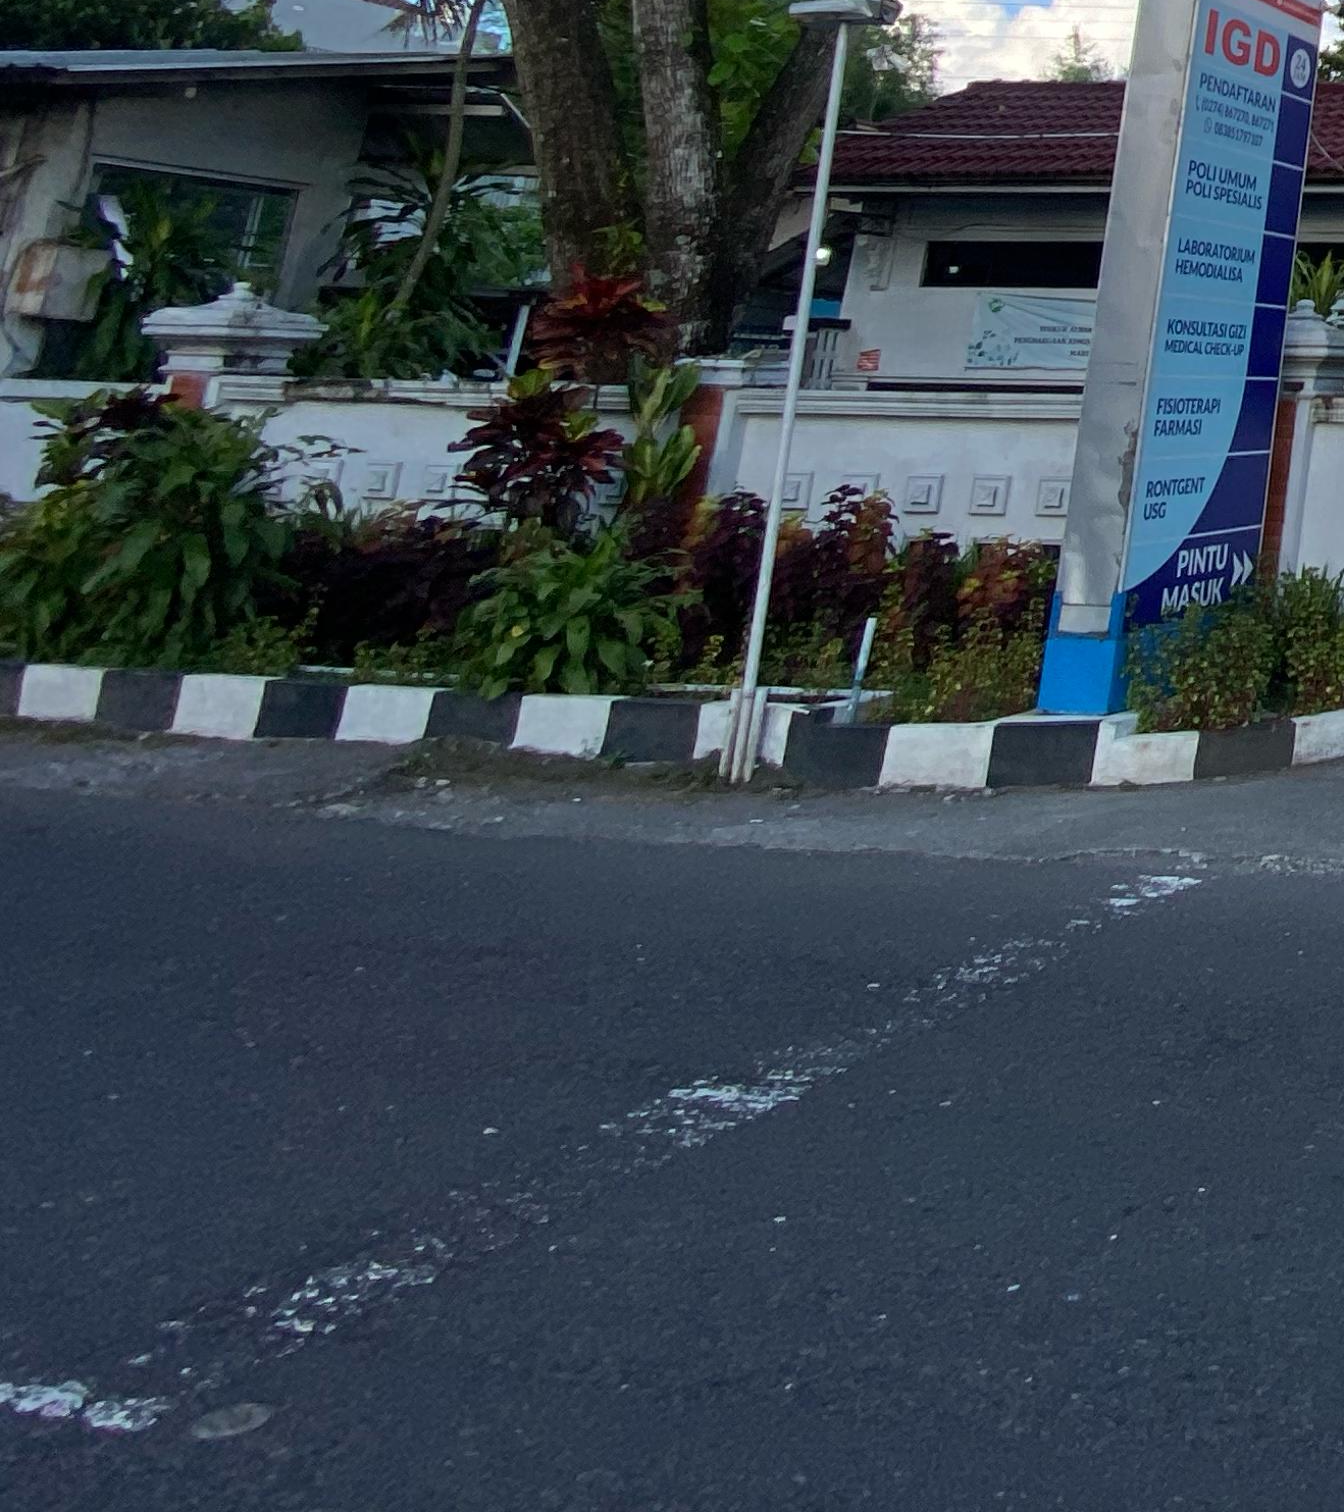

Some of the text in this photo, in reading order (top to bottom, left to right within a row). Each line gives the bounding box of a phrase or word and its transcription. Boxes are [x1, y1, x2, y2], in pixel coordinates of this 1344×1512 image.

[1204, 8, 1280, 77] IGD
[1295, 54, 1307, 72] 24
[1200, 72, 1276, 113] PENDAFTARAN
[1188, 160, 1257, 192] POLI UMUM
[1185, 179, 1263, 210] POLI SPESIALIS
[1178, 237, 1256, 264] LABORATORIUM
[1175, 259, 1243, 283] HEMODIALISA
[1167, 318, 1247, 339] KONSULTASI GIZI
[1165, 340, 1245, 357] MEDICAL CHECK-UP
[1156, 398, 1221, 415] FISIOTERAPI
[1154, 419, 1202, 437] FARMASI
[1146, 477, 1205, 498] RONTGENT
[1144, 501, 1167, 521] USG
[1176, 543, 1229, 579] PINTU
[1160, 577, 1225, 616] MASUK
